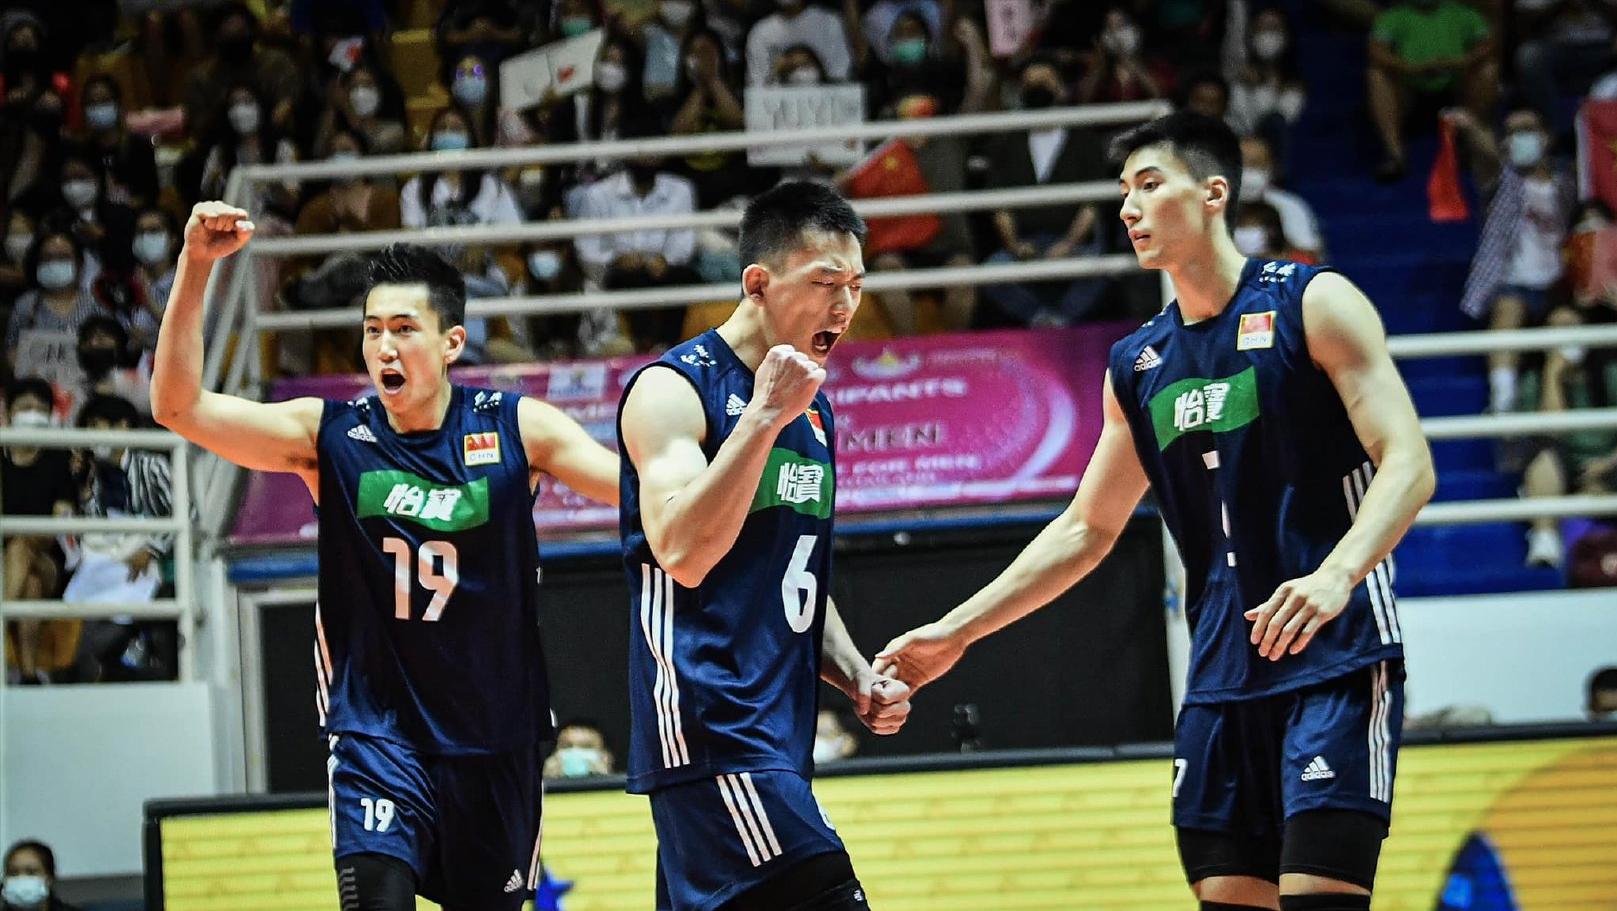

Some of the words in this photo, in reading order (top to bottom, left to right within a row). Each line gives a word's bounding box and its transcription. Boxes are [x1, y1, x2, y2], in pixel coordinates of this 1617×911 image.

[1133, 356, 1163, 372] adidas
[382, 537, 460, 623] 19
[781, 534, 818, 634] 6
[1301, 769, 1337, 782] adidas
[360, 797, 395, 833] 19
